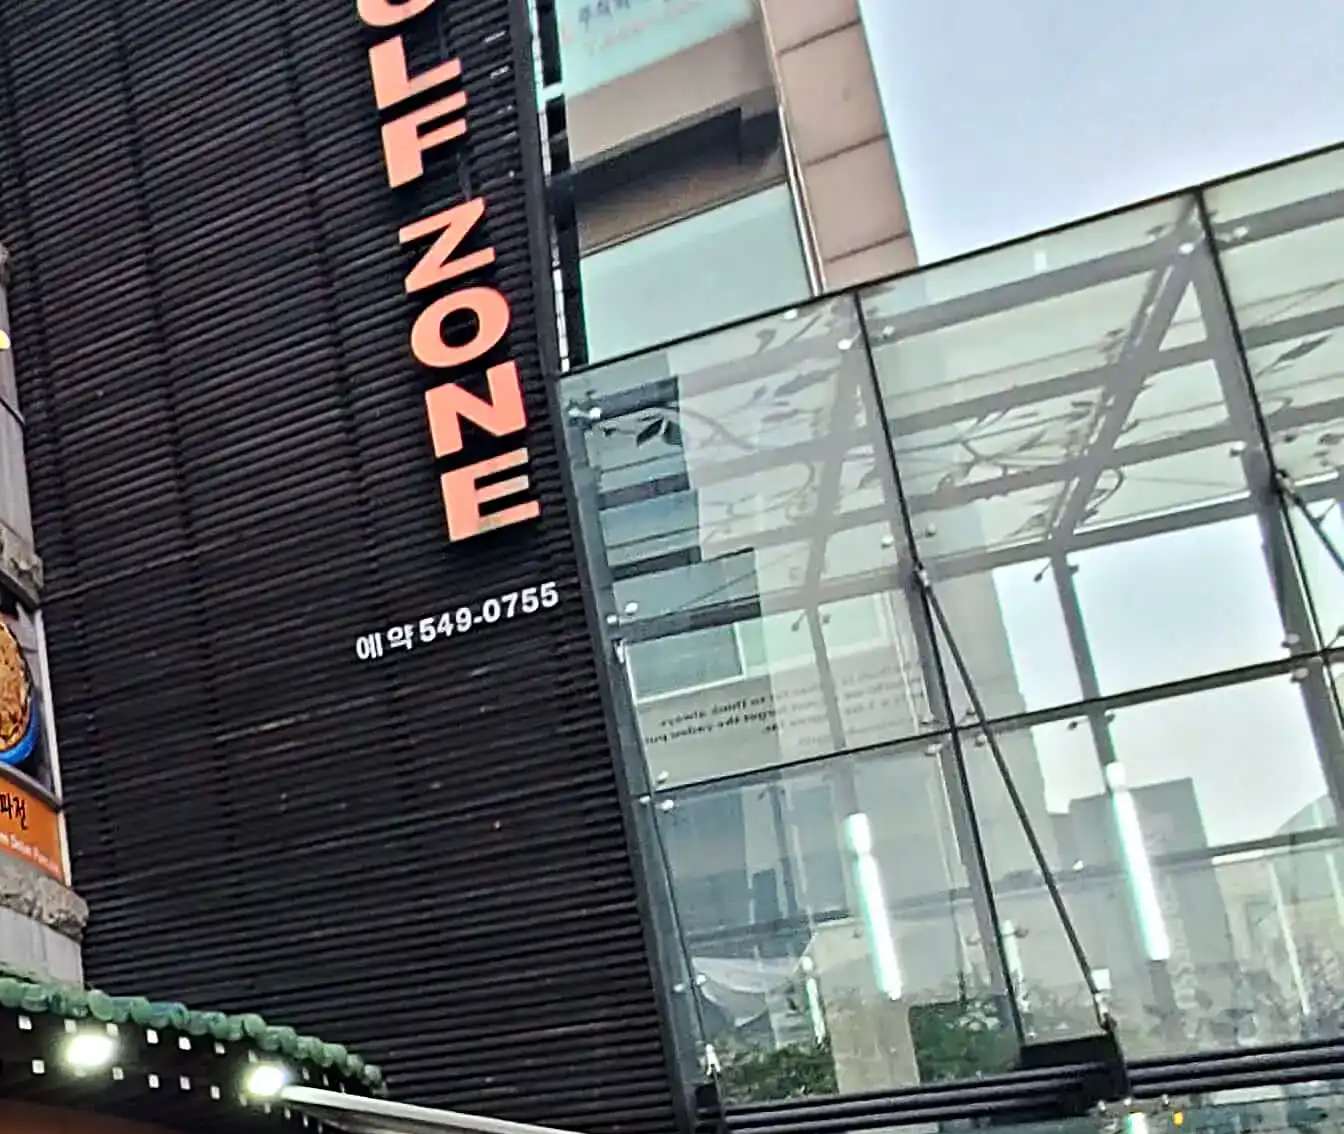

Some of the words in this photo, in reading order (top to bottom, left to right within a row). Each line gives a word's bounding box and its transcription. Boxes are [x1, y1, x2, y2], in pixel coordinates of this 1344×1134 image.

[398, 198, 541, 543] ZONE
[356, 626, 414, 660] 예약
[419, 581, 559, 643] 549-0755
